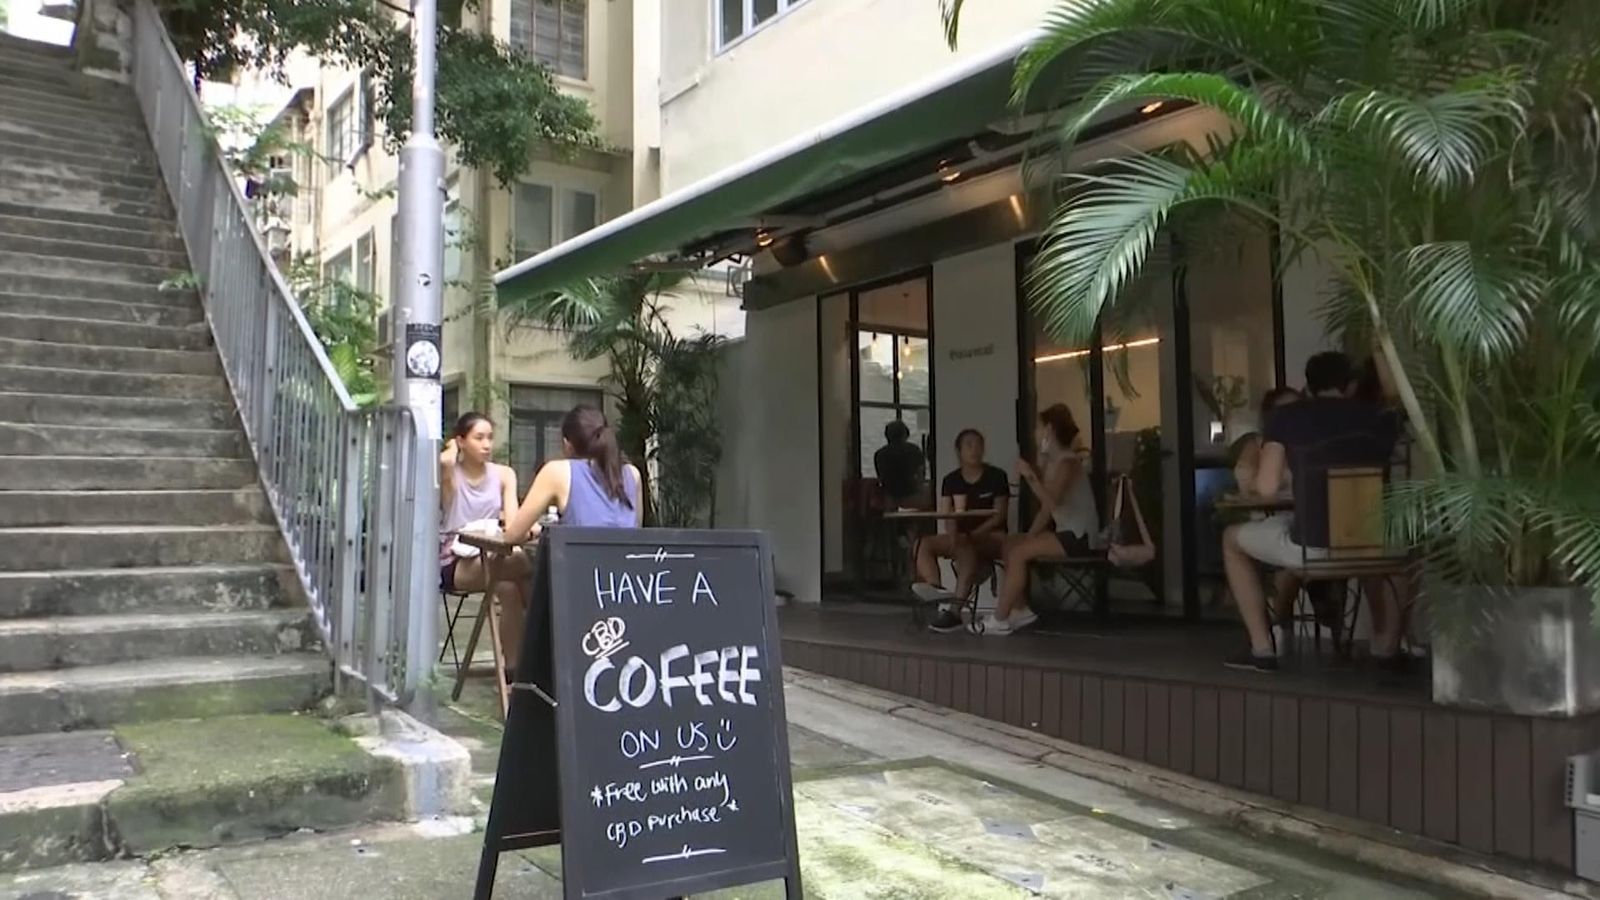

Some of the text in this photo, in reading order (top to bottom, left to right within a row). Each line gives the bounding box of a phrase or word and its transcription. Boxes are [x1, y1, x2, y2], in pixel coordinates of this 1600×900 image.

[594, 567, 719, 609] HAVE A
[582, 616, 630, 656] CBD
[583, 643, 762, 712] COFFEE
[620, 720, 708, 758] ON US
[651, 773, 688, 795] with
[694, 771, 730, 807] any
[606, 820, 642, 848] CBD
